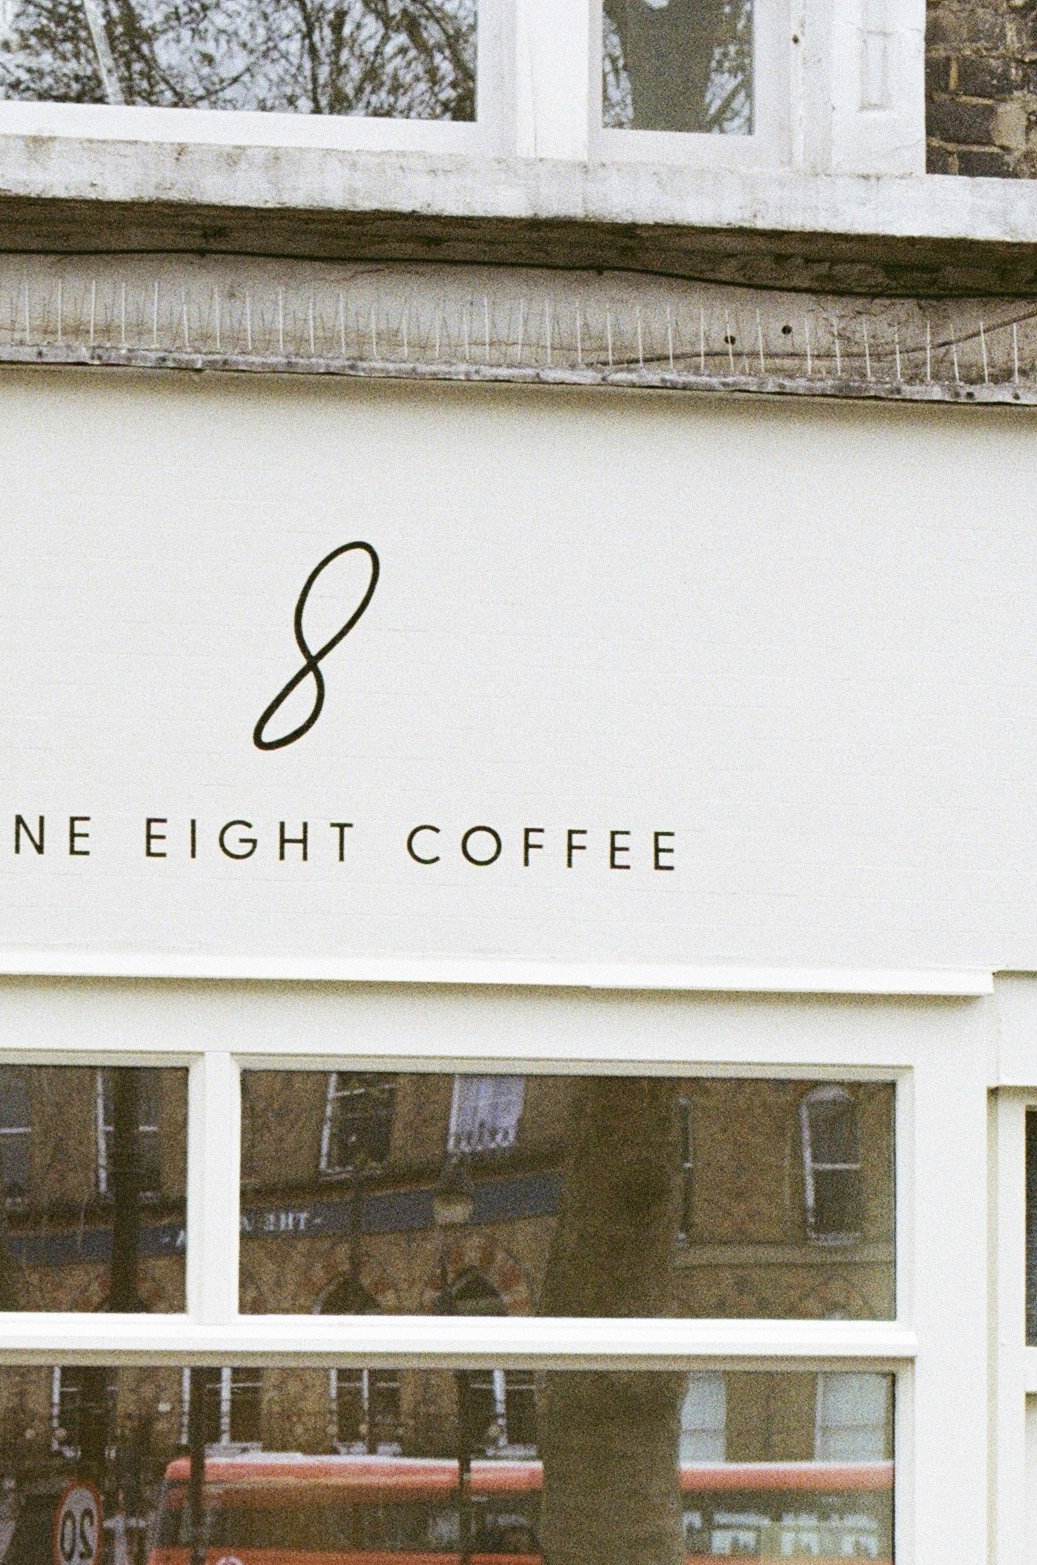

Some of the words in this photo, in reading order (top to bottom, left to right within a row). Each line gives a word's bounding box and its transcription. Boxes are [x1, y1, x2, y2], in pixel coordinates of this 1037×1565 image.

[252, 540, 380, 751] 8
[145, 817, 353, 862] EIGHT
[406, 824, 675, 871] COFFEE
